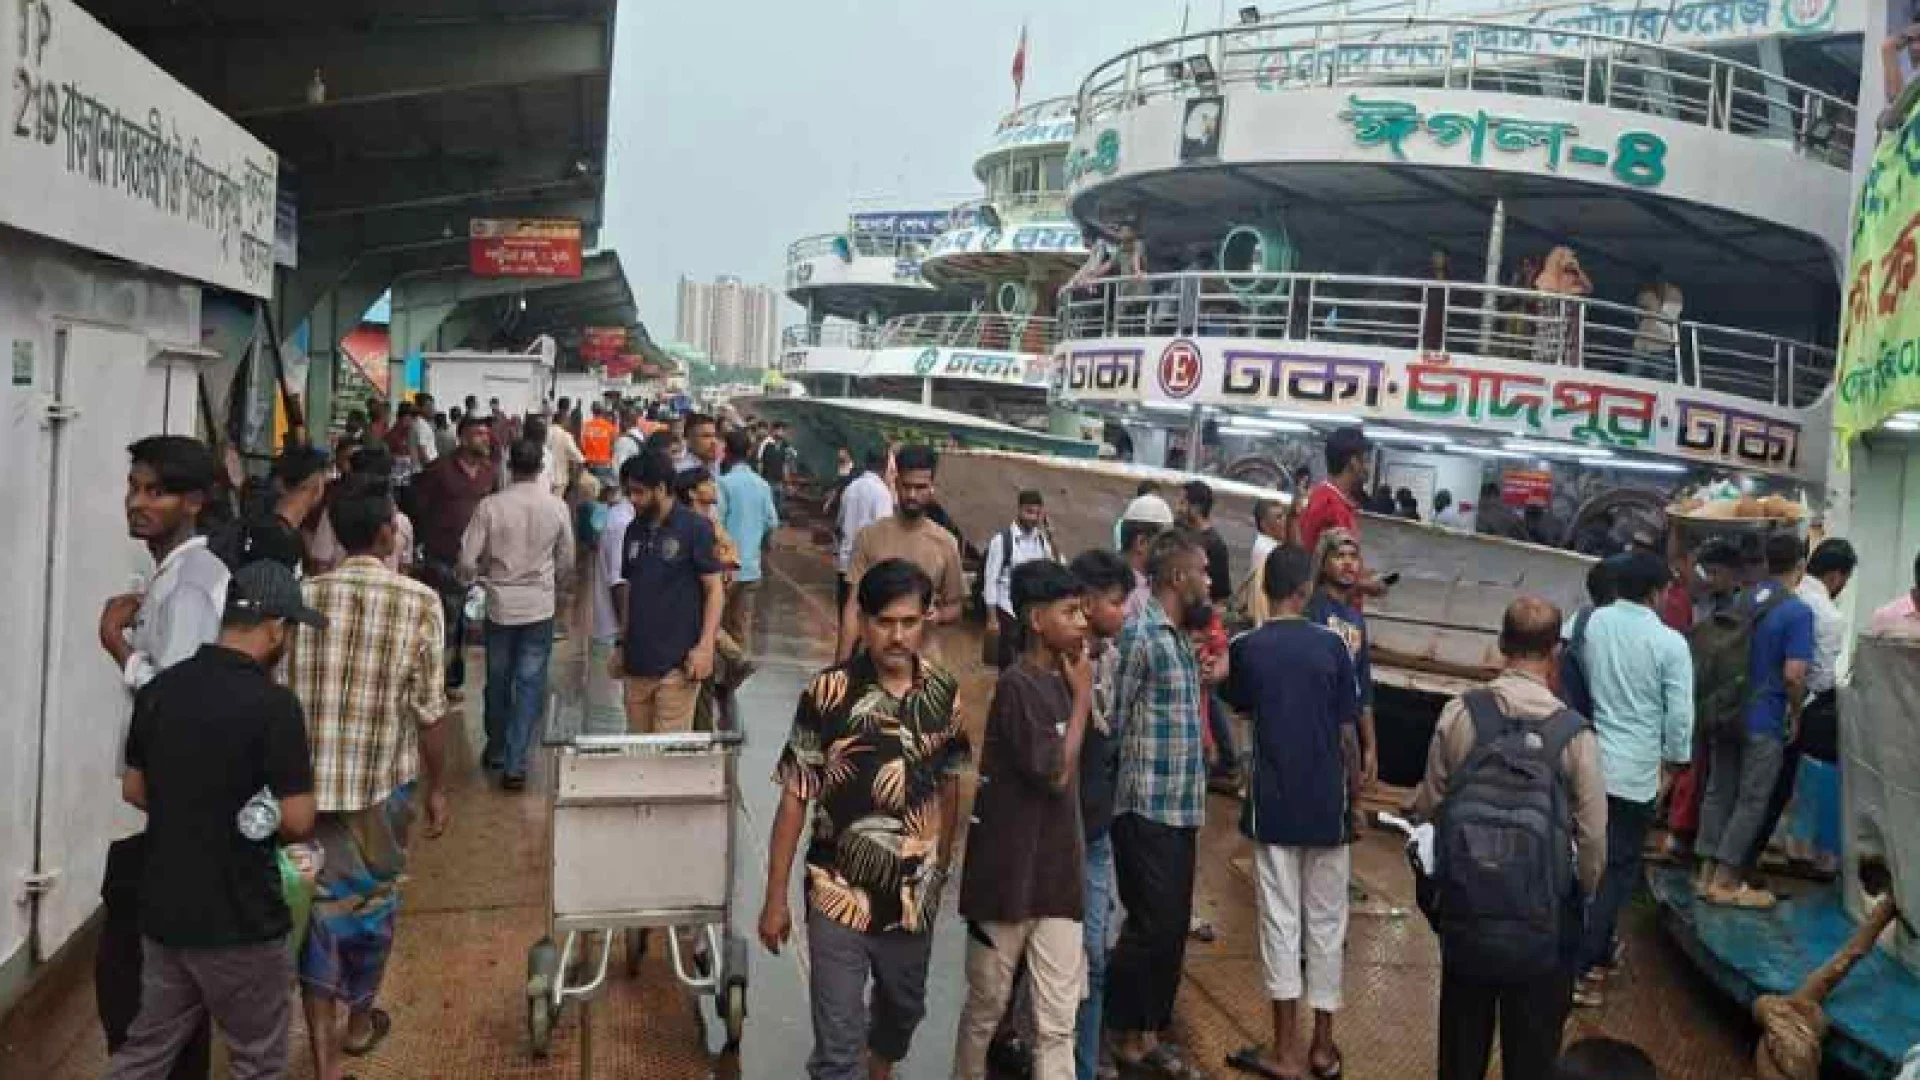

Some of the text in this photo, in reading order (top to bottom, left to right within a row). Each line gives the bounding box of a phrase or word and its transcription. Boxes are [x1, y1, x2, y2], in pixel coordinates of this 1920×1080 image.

[13, 66, 58, 145] 219
[1070, 348, 1145, 390] ঢাকা
[1223, 349, 1801, 468] ঢাকা চাঁদপুর ঢাকা
